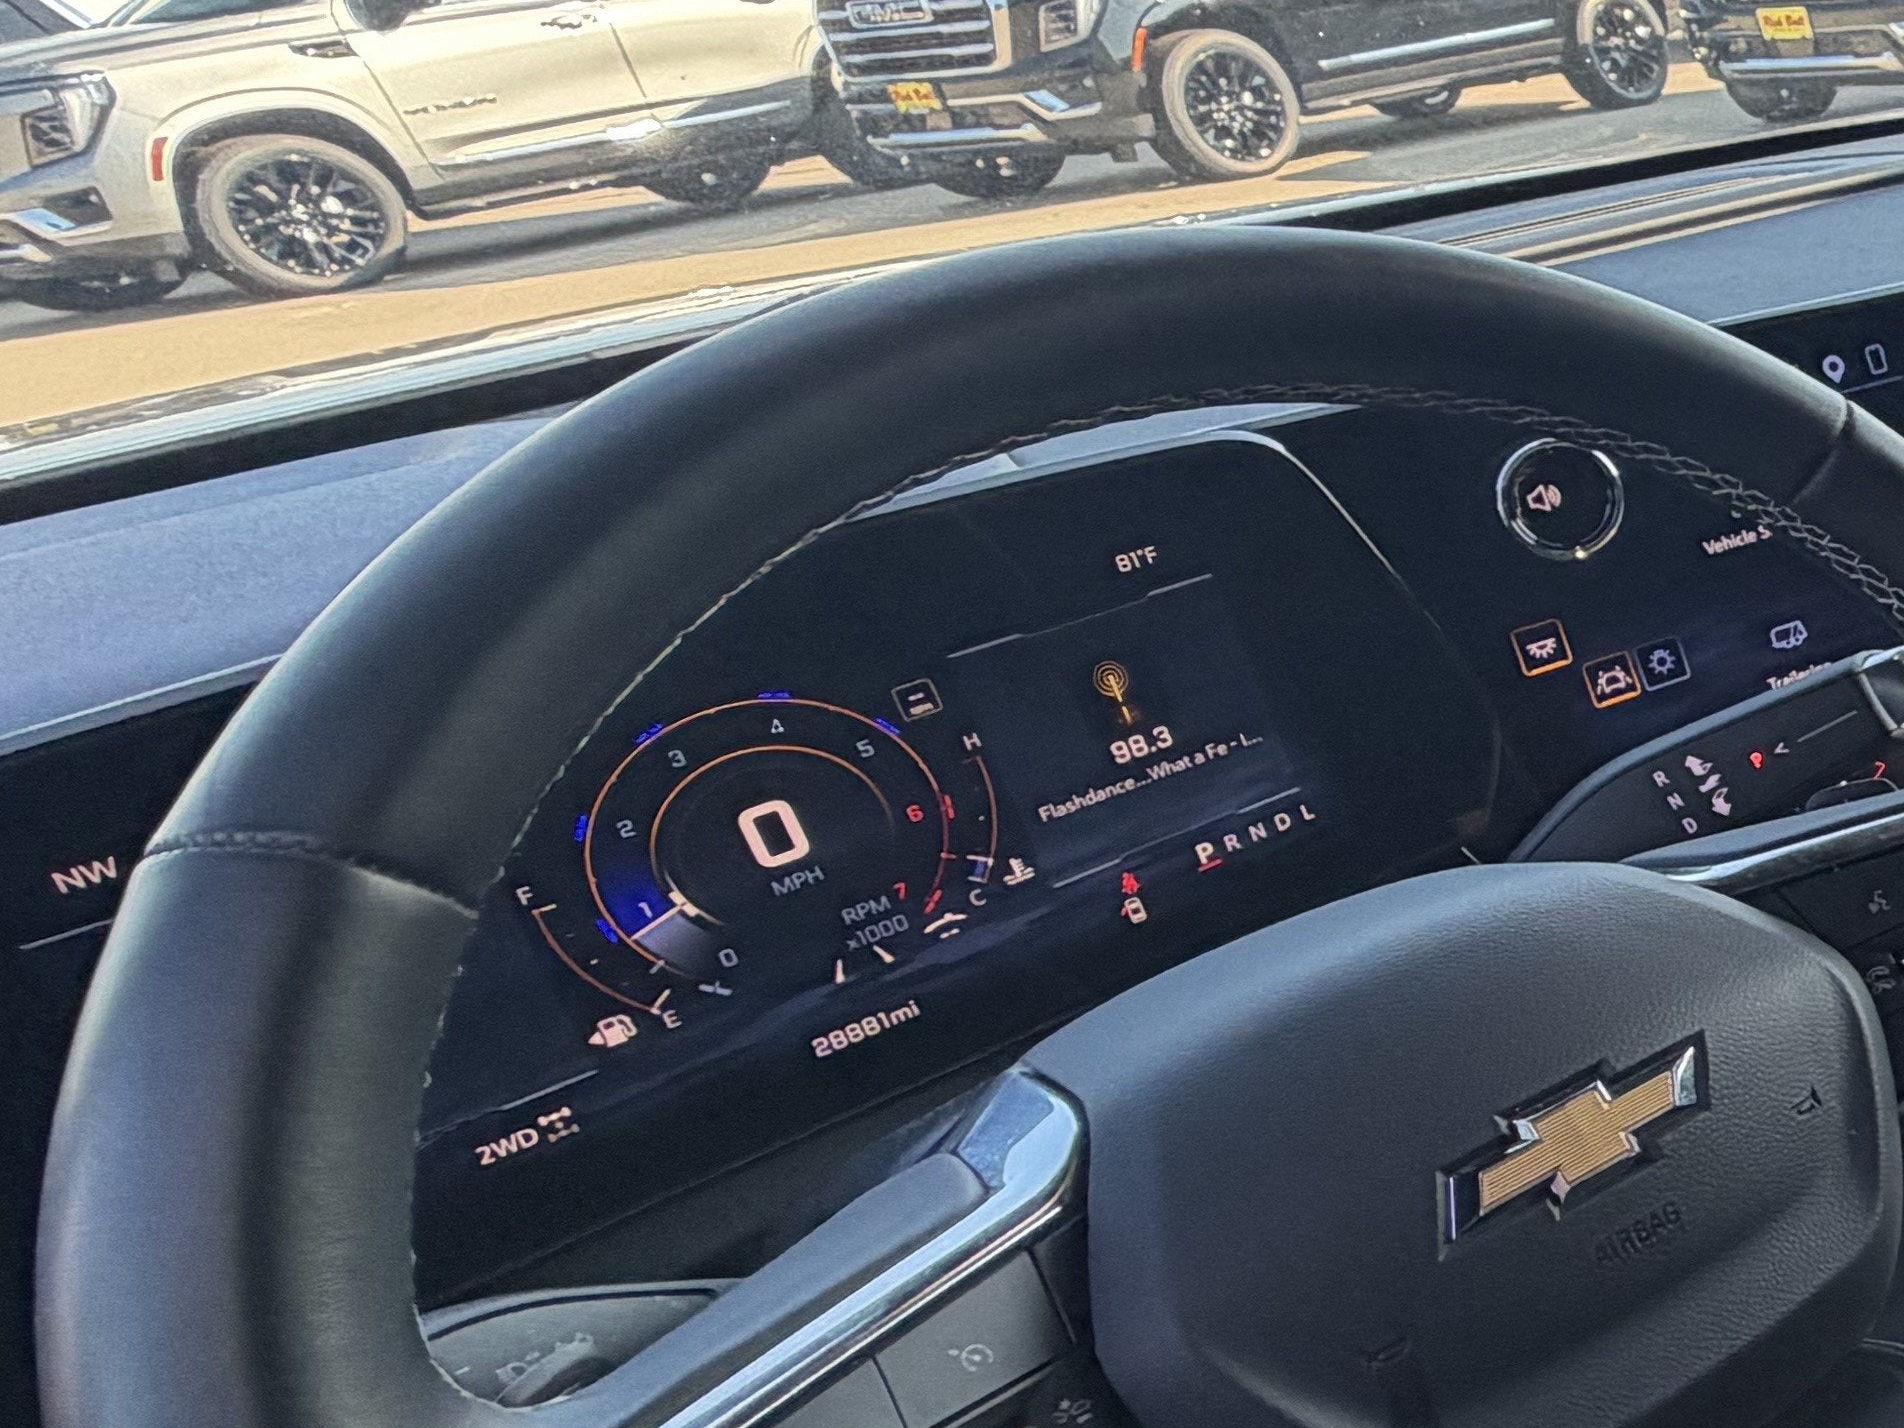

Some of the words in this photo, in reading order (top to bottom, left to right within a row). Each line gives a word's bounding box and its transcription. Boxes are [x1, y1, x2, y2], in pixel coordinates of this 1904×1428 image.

[1702, 529, 1758, 555] Vehicle
[1115, 545, 1158, 573] 81°F
[856, 740, 876, 759] 5
[962, 732, 982, 751] H
[1109, 725, 1174, 765] 98.3
[667, 749, 687, 769] 3
[1193, 752, 1206, 765] a
[1204, 741, 1229, 760] Fe
[1653, 770, 1671, 788] R
[1667, 792, 1685, 811] N
[906, 803, 925, 823] 6
[616, 819, 637, 839] 2
[738, 799, 810, 868] 0
[1195, 842, 1214, 865] P
[1223, 833, 1242, 853] R
[1248, 822, 1268, 842] N
[1273, 812, 1291, 832] D
[1300, 804, 1316, 821] L
[1682, 817, 1698, 834] D
[51, 856, 118, 894] NW
[770, 865, 826, 898] MPH
[515, 886, 535, 906] F
[893, 881, 907, 900] 7
[969, 887, 987, 907] C
[638, 901, 654, 919] 1
[841, 895, 892, 926] RPM
[845, 914, 909, 951] x1000
[718, 947, 740, 968] 0
[662, 1009, 683, 1029] E
[811, 999, 922, 1059] 28881mi
[474, 1127, 540, 1166] 2WD
